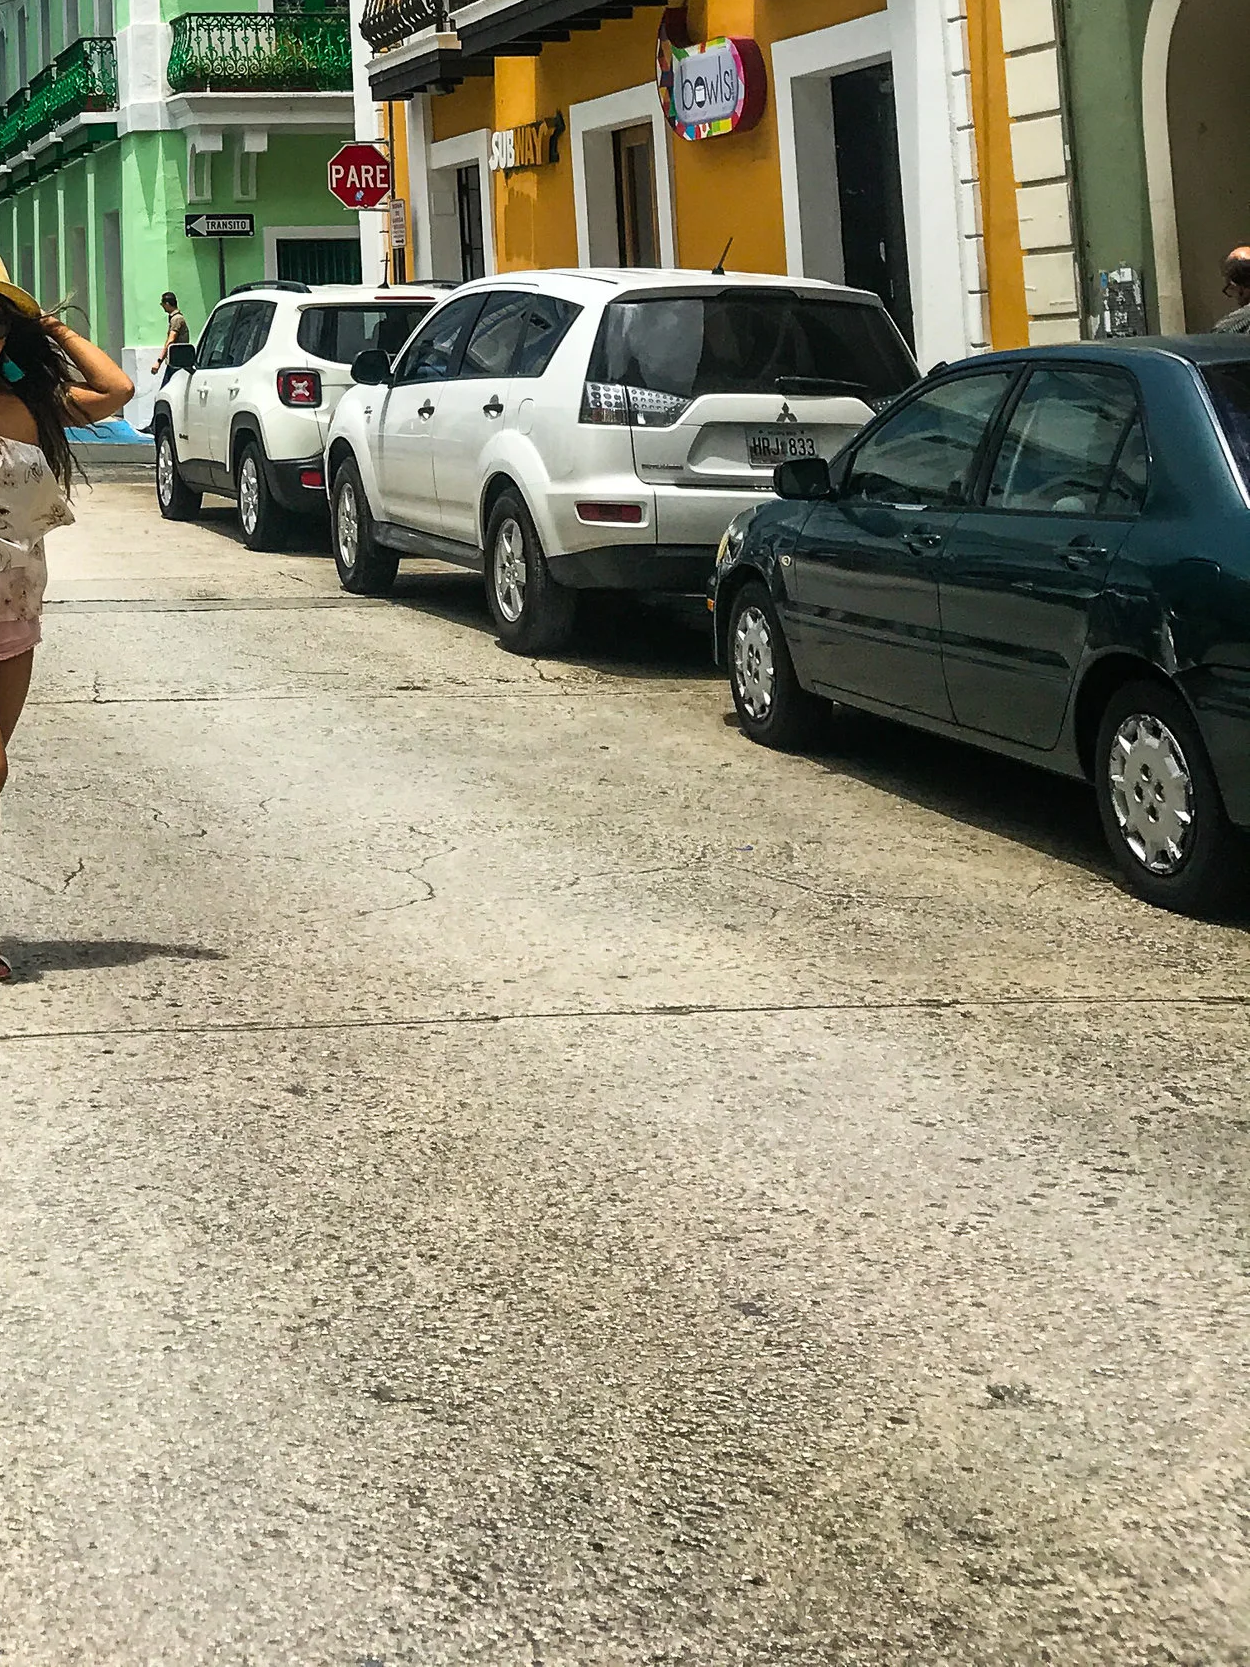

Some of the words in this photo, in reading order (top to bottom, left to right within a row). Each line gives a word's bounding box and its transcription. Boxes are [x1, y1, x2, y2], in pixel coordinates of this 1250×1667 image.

[488, 120, 547, 171] SUBWAY
[331, 165, 389, 188] PARE
[205, 220, 247, 230] TRANSITO
[752, 437, 780, 456] HRJ
[788, 437, 816, 456] 833
